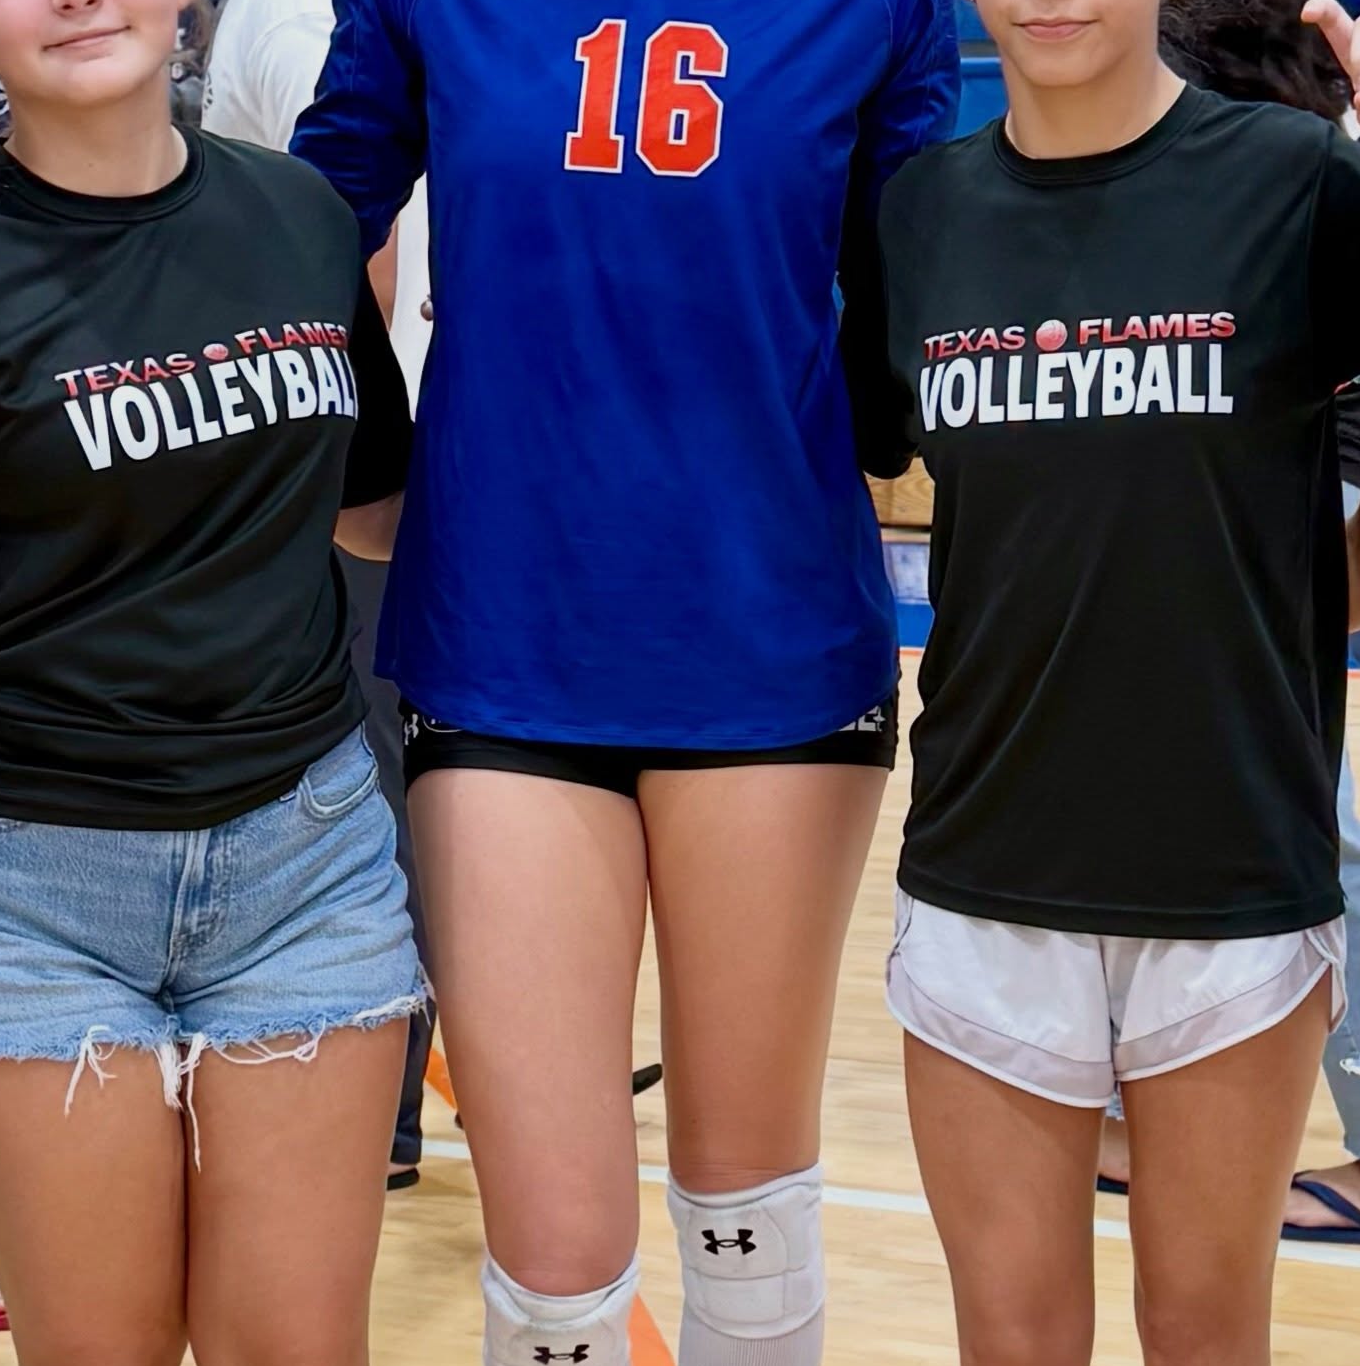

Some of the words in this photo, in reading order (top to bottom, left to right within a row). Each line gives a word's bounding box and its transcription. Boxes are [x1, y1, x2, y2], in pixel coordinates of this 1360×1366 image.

[564, 18, 729, 177] 16
[923, 326, 1026, 360] TEXAS
[1079, 312, 1236, 345] FLAMES
[55, 352, 196, 397] TEXAS
[920, 344, 1234, 433] VOLLEYBALL
